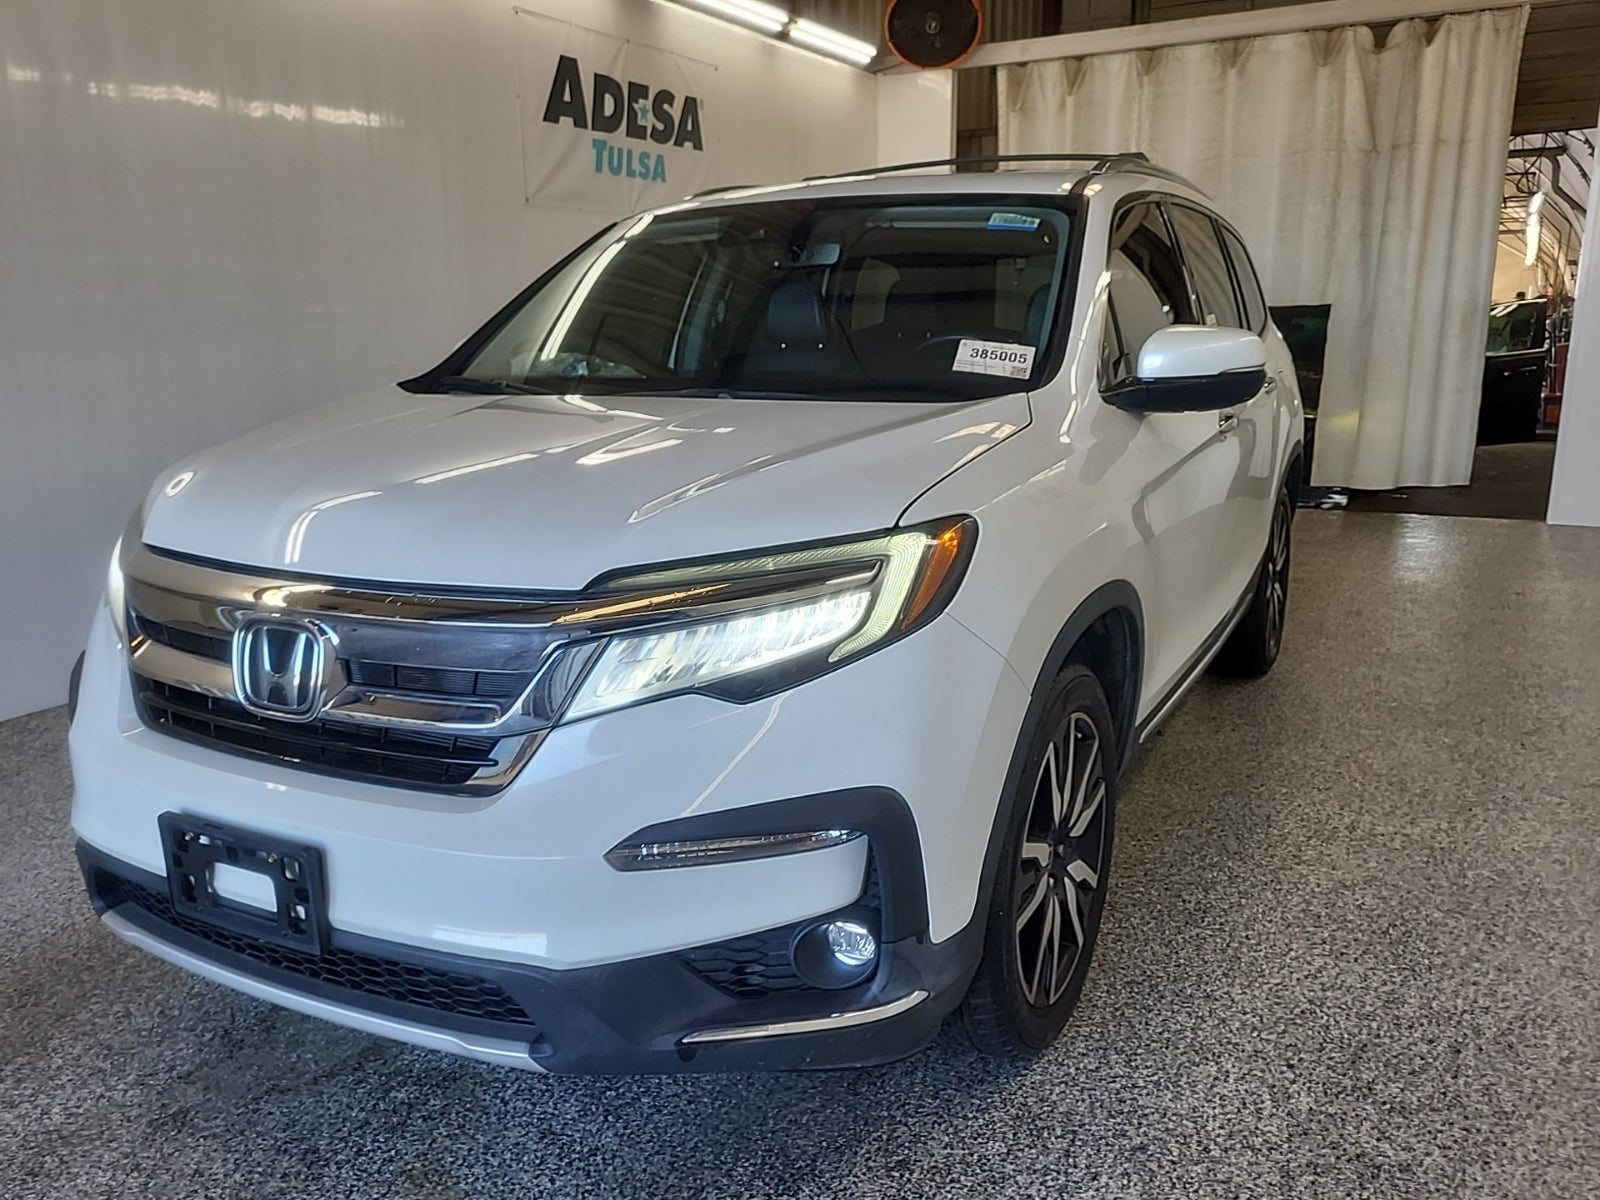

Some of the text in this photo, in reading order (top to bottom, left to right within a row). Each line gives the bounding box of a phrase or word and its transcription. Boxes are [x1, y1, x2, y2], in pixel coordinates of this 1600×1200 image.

[542, 54, 704, 152] ADESA
[592, 138, 667, 183] TULSA
[970, 348, 1028, 364] 385005
